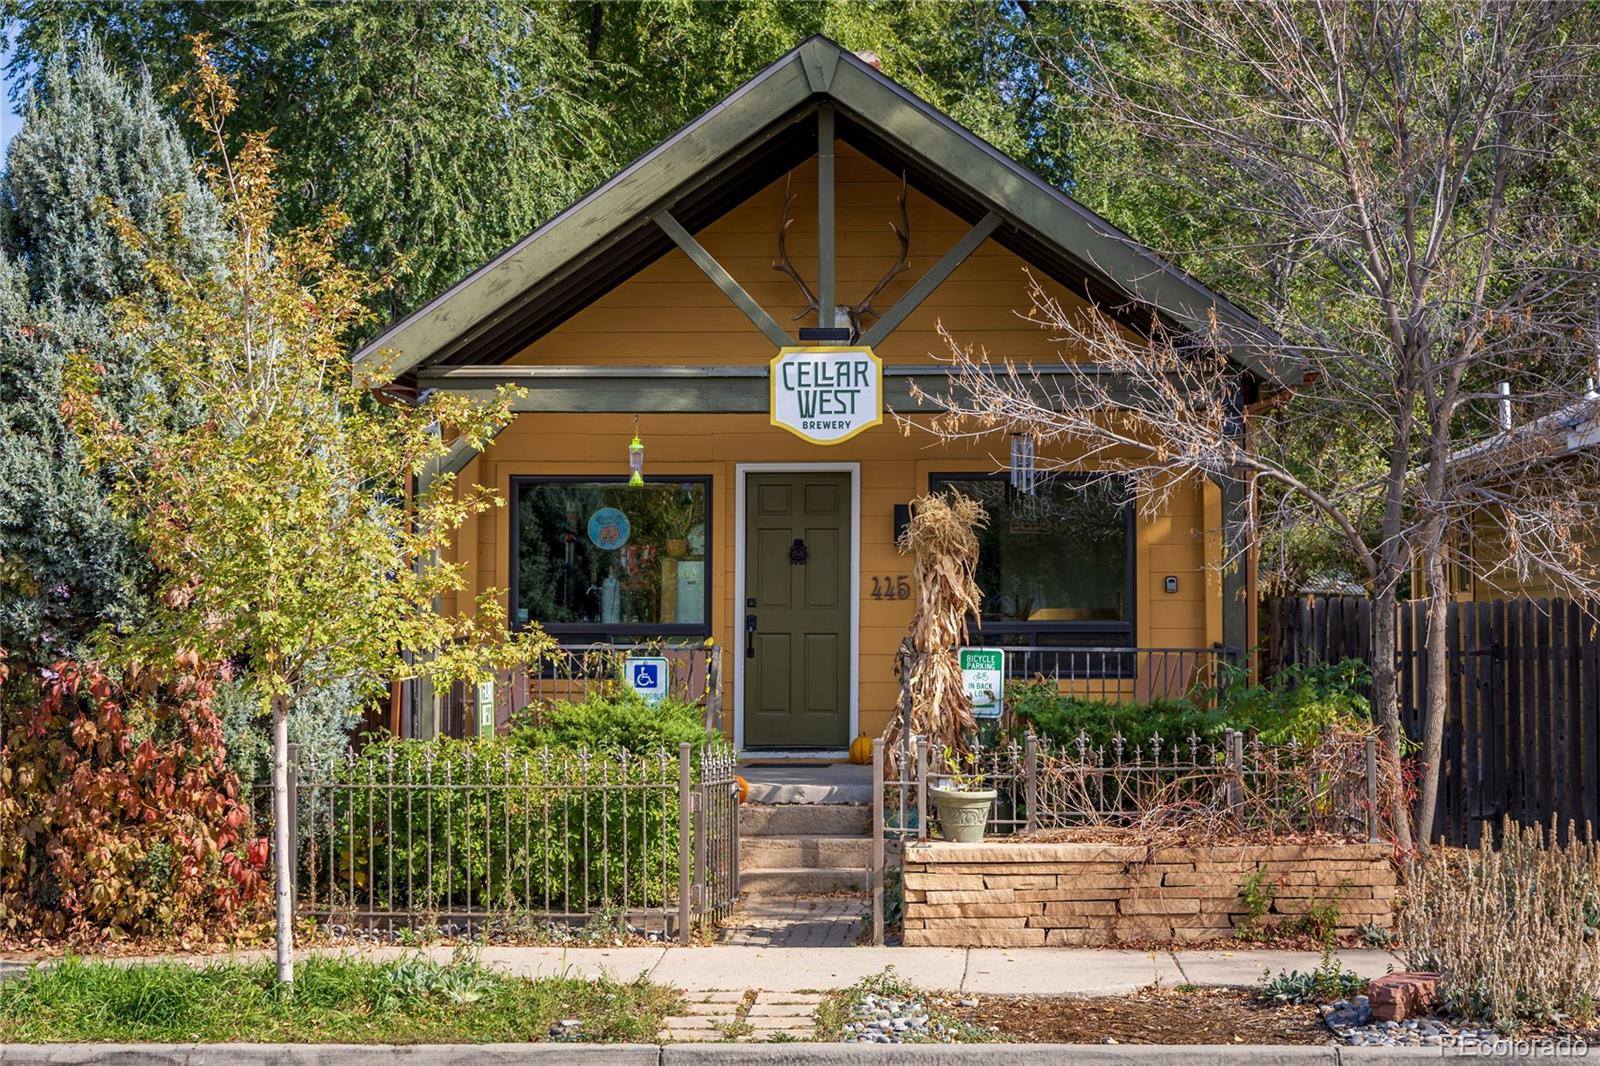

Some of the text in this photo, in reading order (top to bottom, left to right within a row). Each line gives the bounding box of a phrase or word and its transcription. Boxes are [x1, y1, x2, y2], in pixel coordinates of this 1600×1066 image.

[783, 361, 869, 391] CELLAR
[797, 389, 861, 418] WEST
[802, 421, 851, 430] BREWERY
[966, 655, 996, 663] BICYCLE
